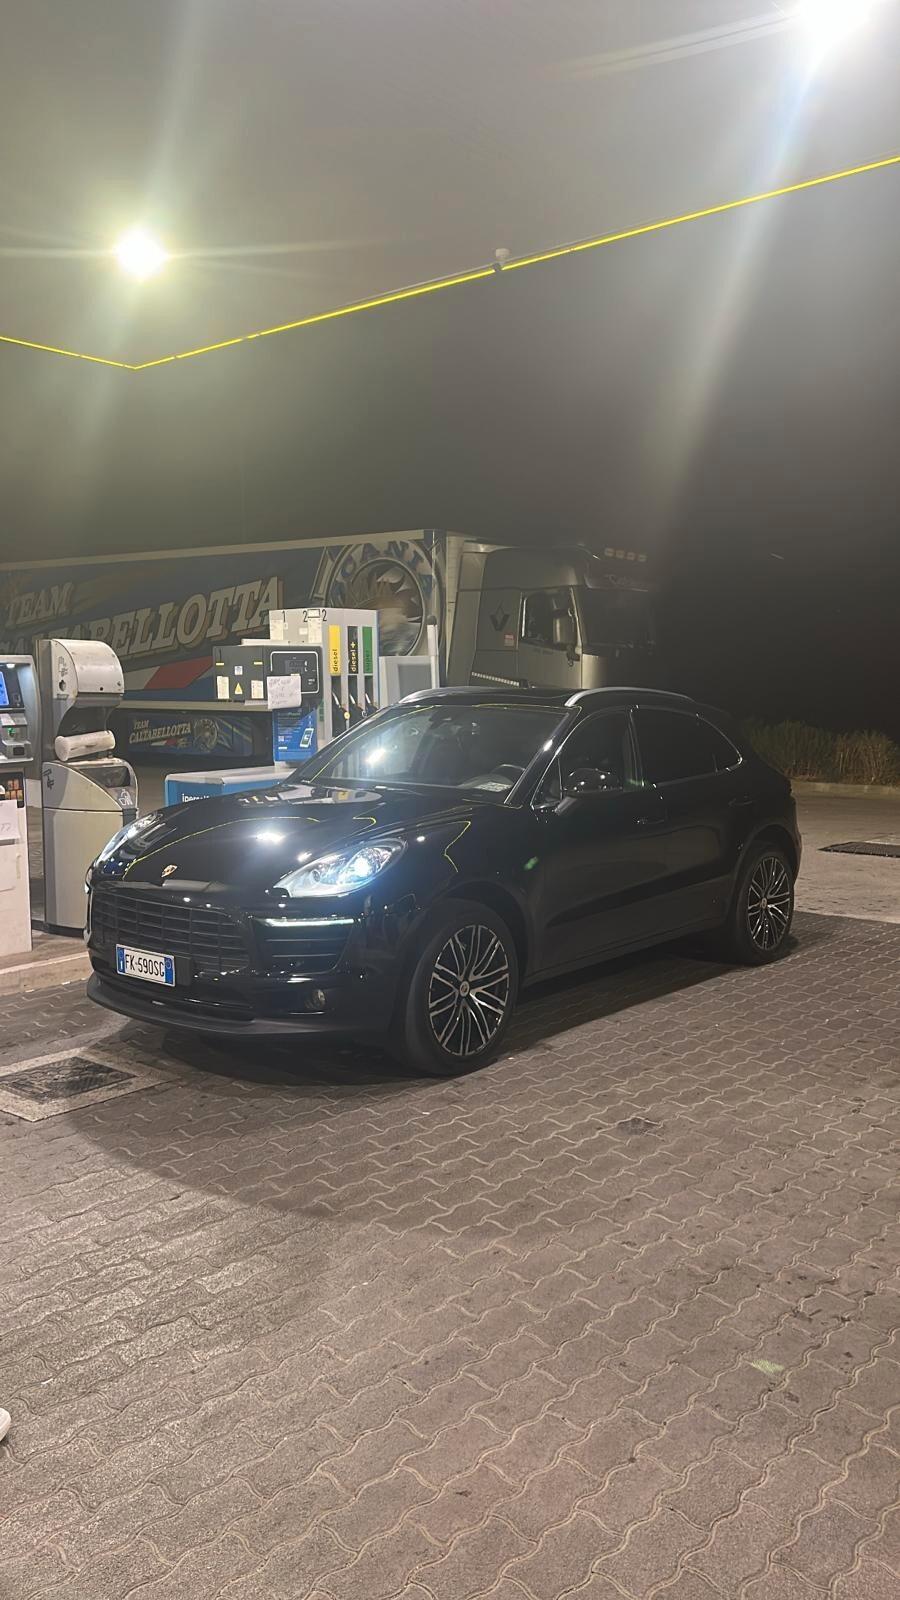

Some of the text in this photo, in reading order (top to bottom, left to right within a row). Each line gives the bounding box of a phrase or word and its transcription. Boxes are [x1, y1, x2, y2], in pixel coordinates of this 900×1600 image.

[4, 581, 74, 627] TEAM
[0, 576, 278, 658] BELLOTTA
[283, 610, 308, 623] 1 2
[322, 609, 328, 622] 2
[133, 719, 150, 730] TEAM
